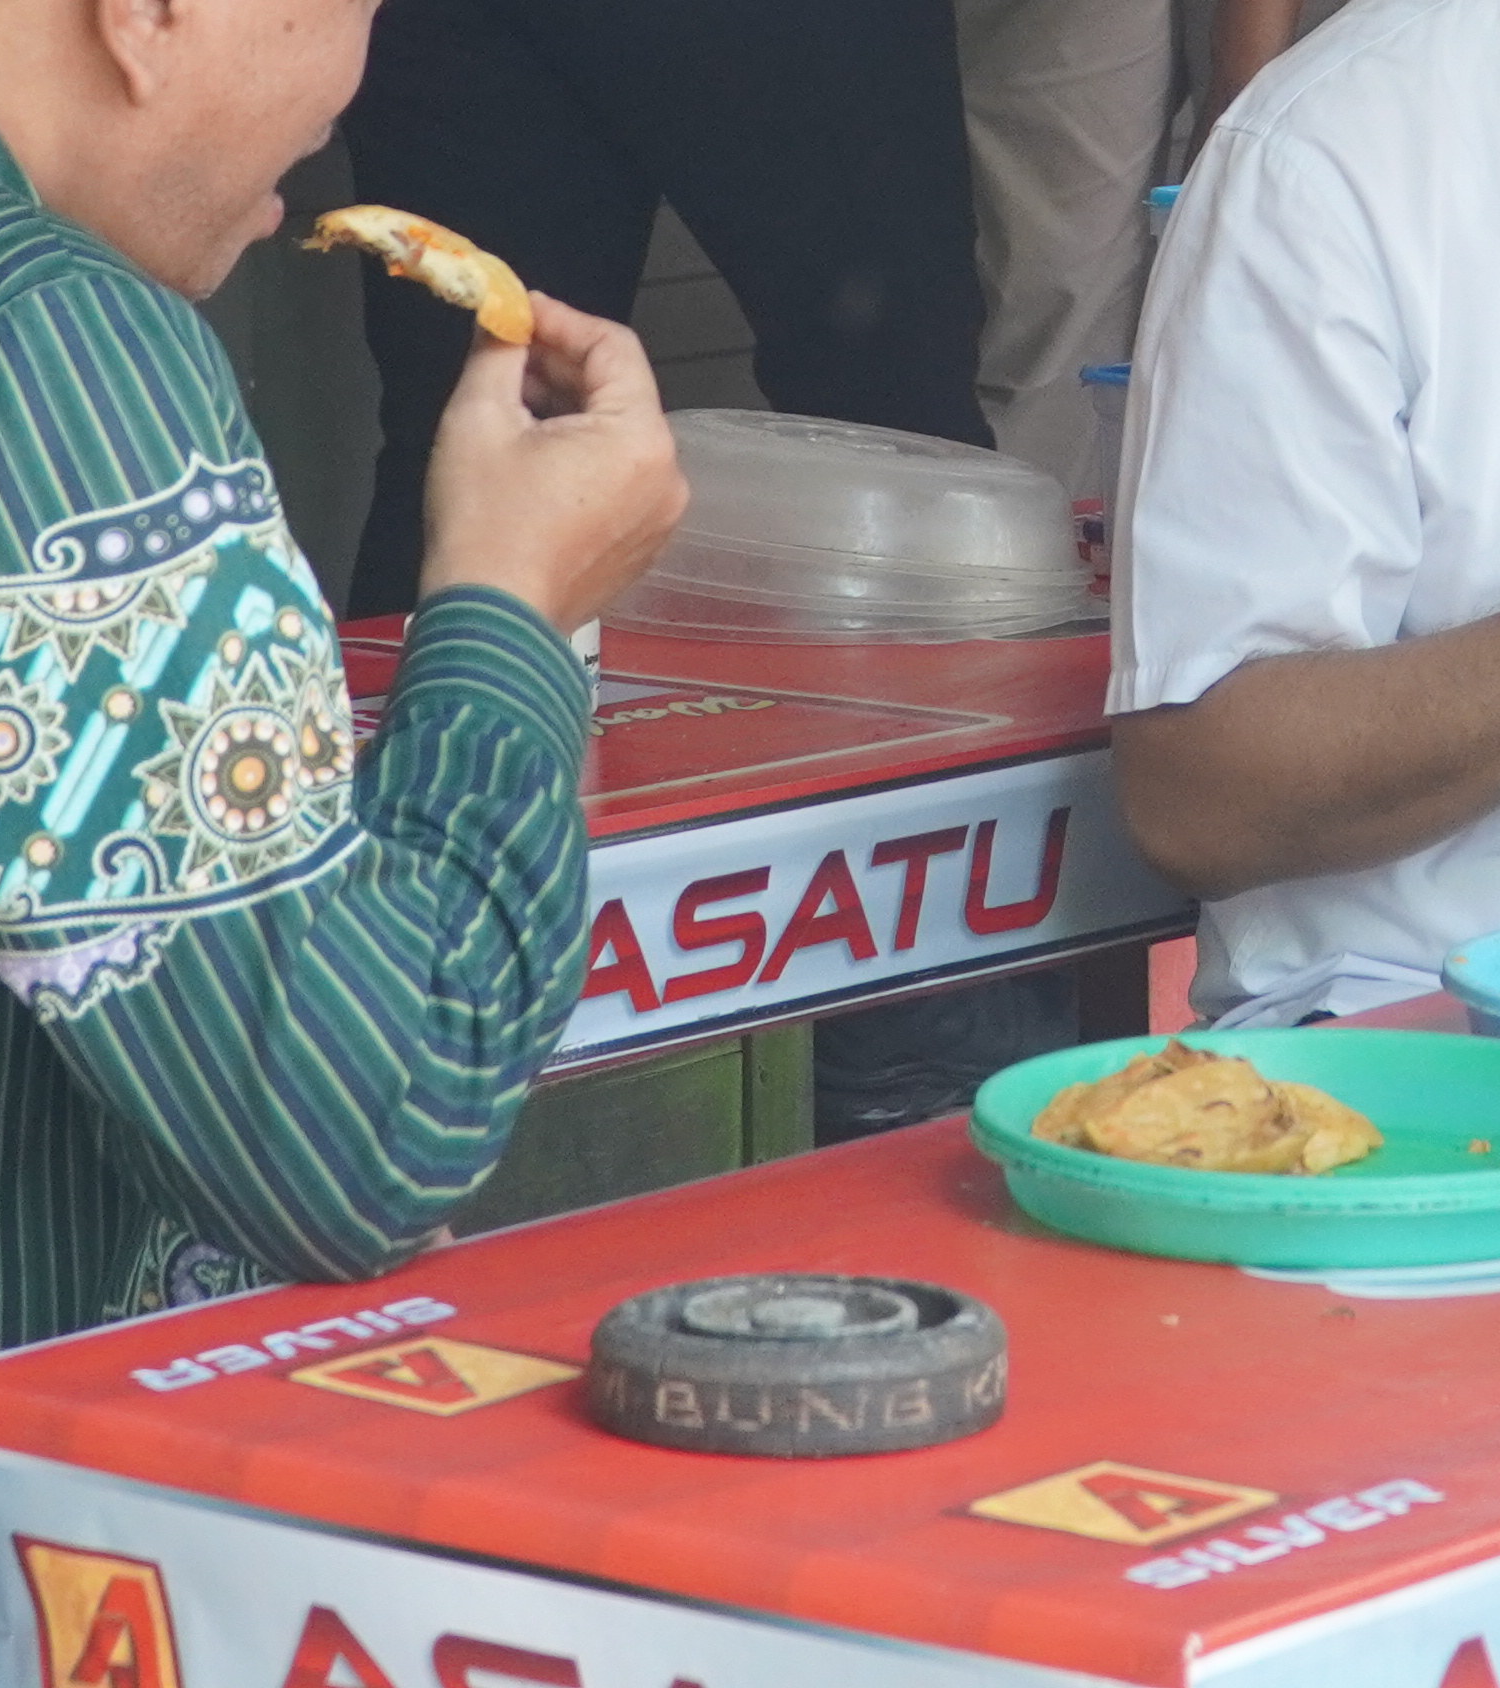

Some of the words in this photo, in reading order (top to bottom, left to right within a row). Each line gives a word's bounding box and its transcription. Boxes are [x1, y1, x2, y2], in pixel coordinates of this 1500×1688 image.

[578, 807, 1072, 1014] ASATU
[130, 1295, 459, 1393] SILVER
[655, 1376, 934, 1434] BUNG
[1122, 1478, 1445, 1590] SILVER
